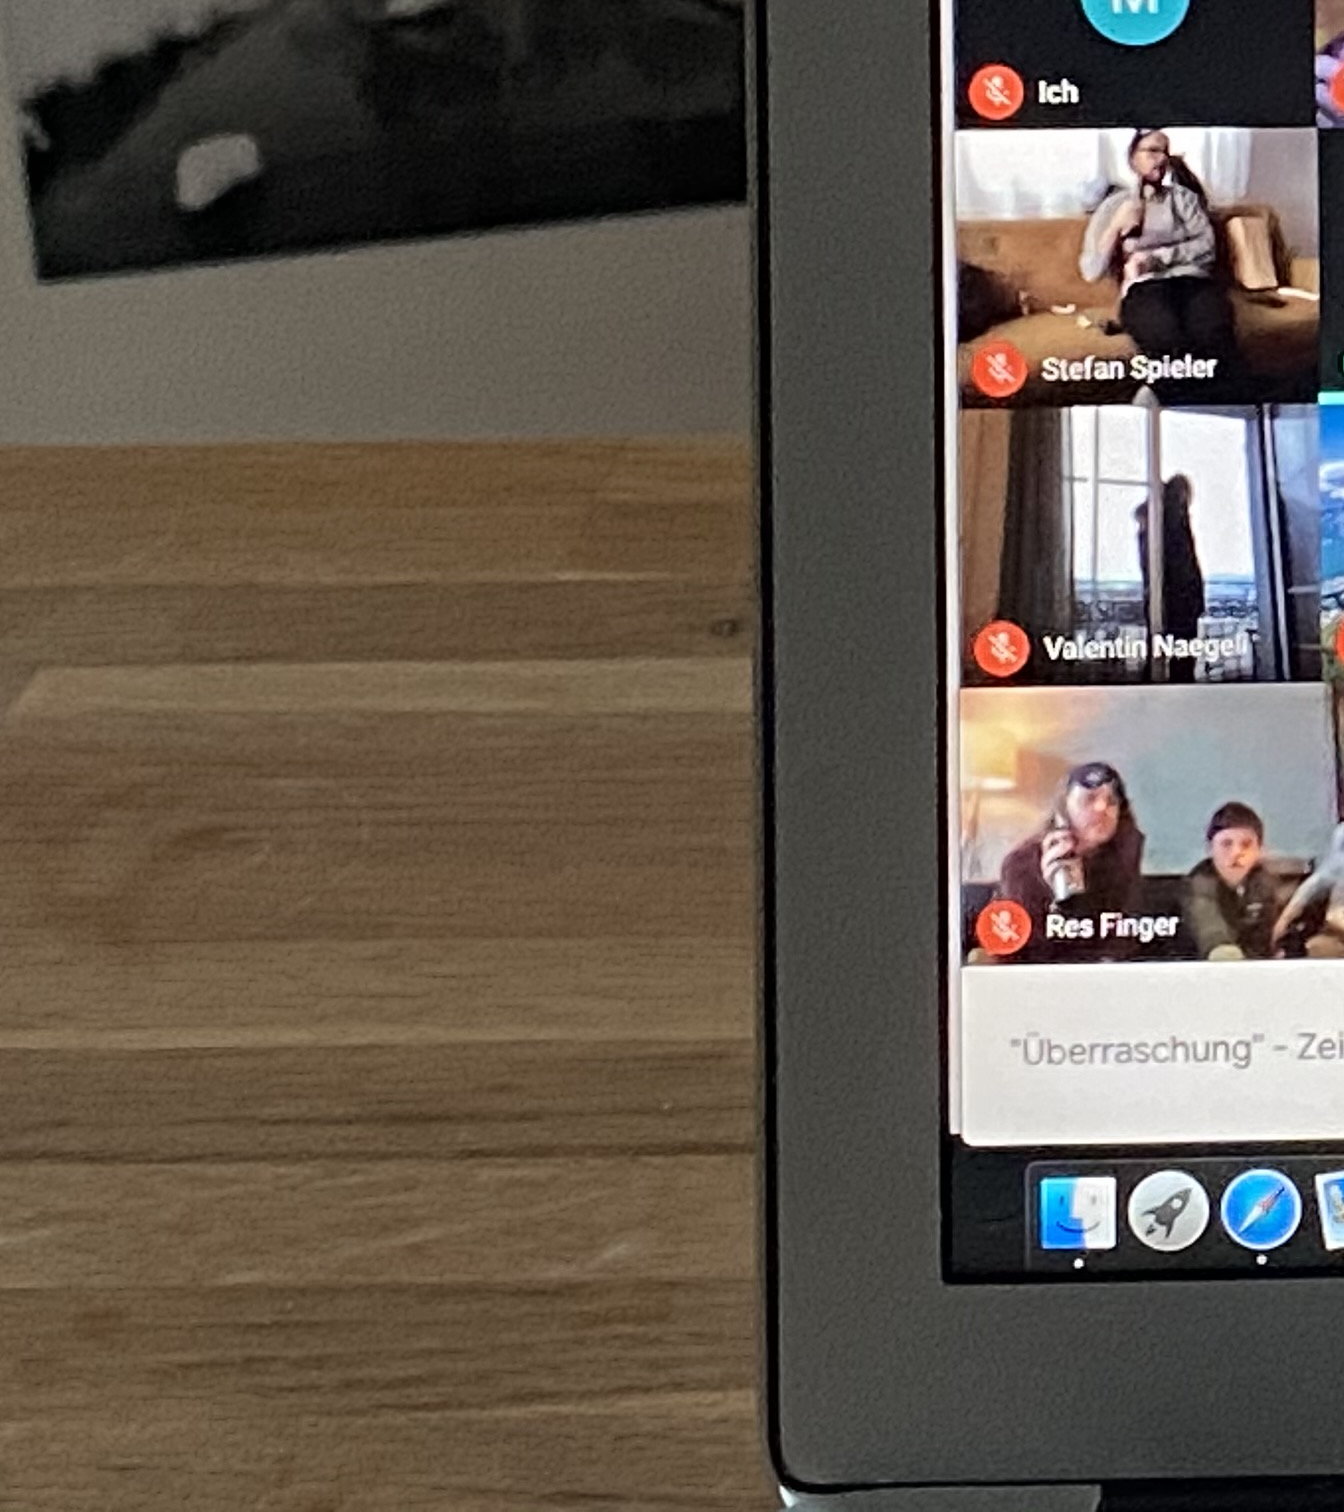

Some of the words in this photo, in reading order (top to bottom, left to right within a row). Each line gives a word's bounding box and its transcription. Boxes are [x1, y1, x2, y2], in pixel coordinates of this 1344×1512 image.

[1037, 79, 1080, 104] Ich
[1042, 355, 1123, 384] Stefan
[1131, 354, 1218, 387] Spieler
[1043, 633, 1145, 661] Valentin
[1046, 913, 1094, 940] Res
[1100, 912, 1179, 943] Finger
